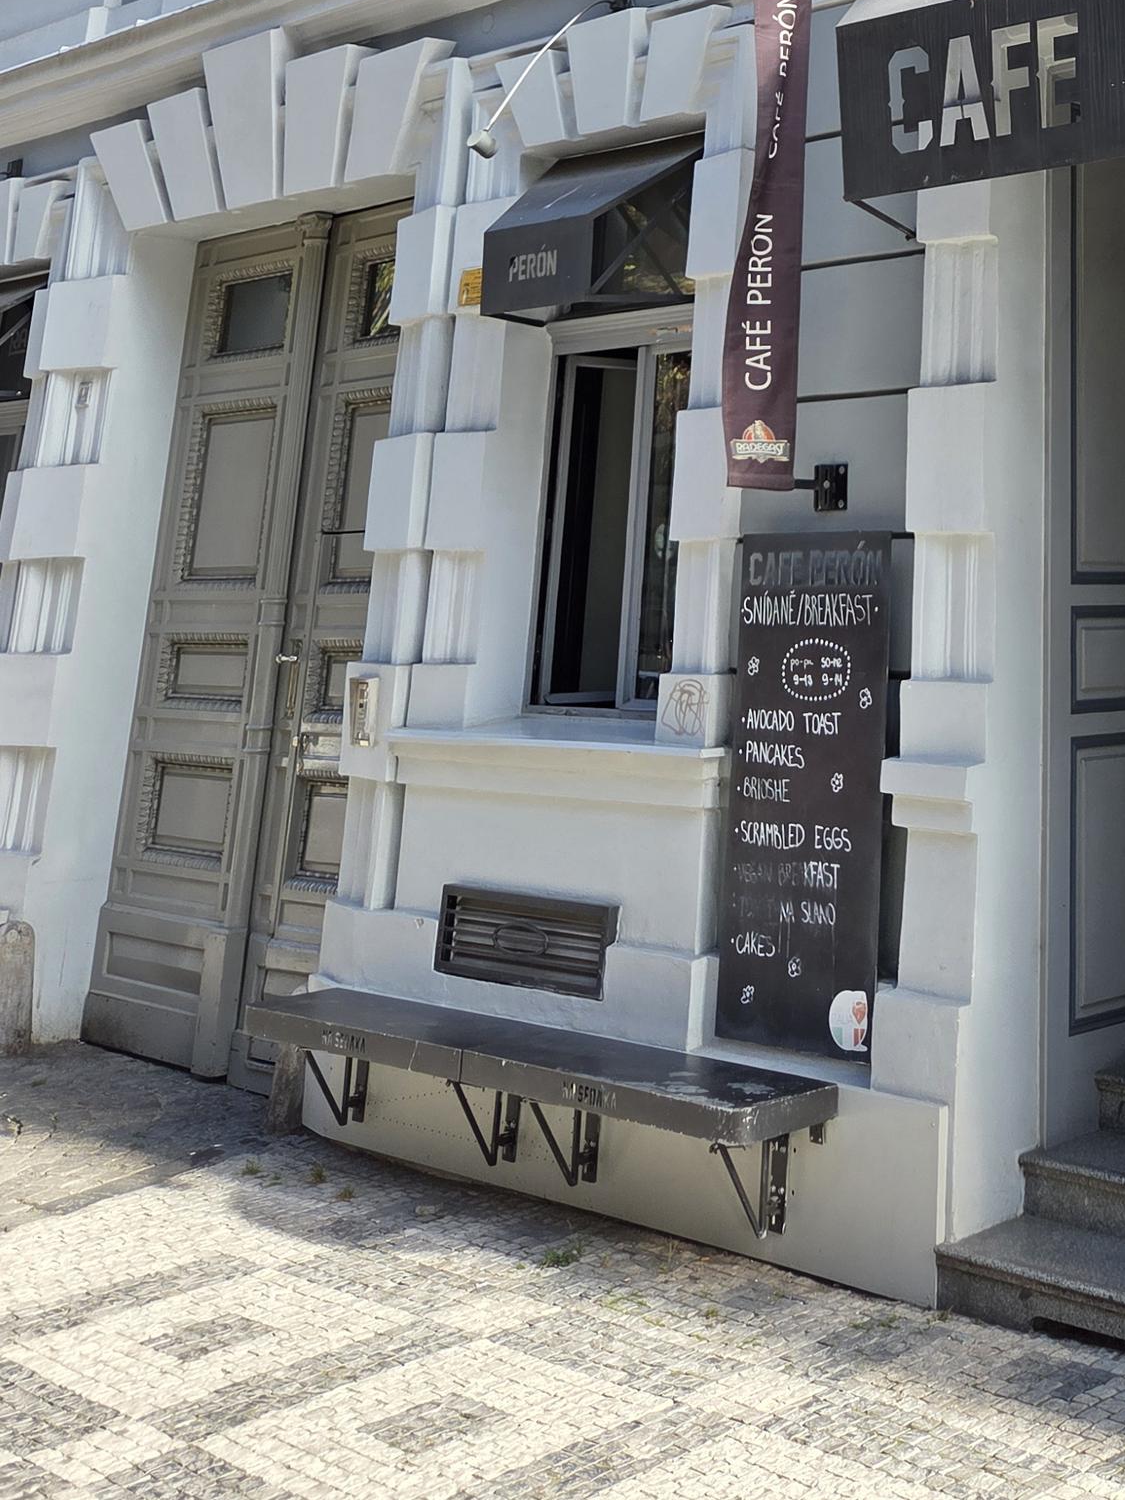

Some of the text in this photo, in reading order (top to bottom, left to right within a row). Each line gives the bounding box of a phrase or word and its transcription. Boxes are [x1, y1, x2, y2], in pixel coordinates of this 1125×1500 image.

[888, 12, 1081, 154] CAFE
[508, 244, 558, 283] PERÓN
[741, 320, 772, 391] CAFÉ
[749, 551, 804, 587] CAFE
[746, 708, 842, 736] AVOCADO TOAST
[745, 740, 805, 769] PANCAKES
[743, 776, 791, 803] BRIOSHE
[740, 820, 851, 852] SCRAMBLED EGGS
[778, 860, 841, 890] BREKFAST
[736, 931, 776, 957] CAKES
